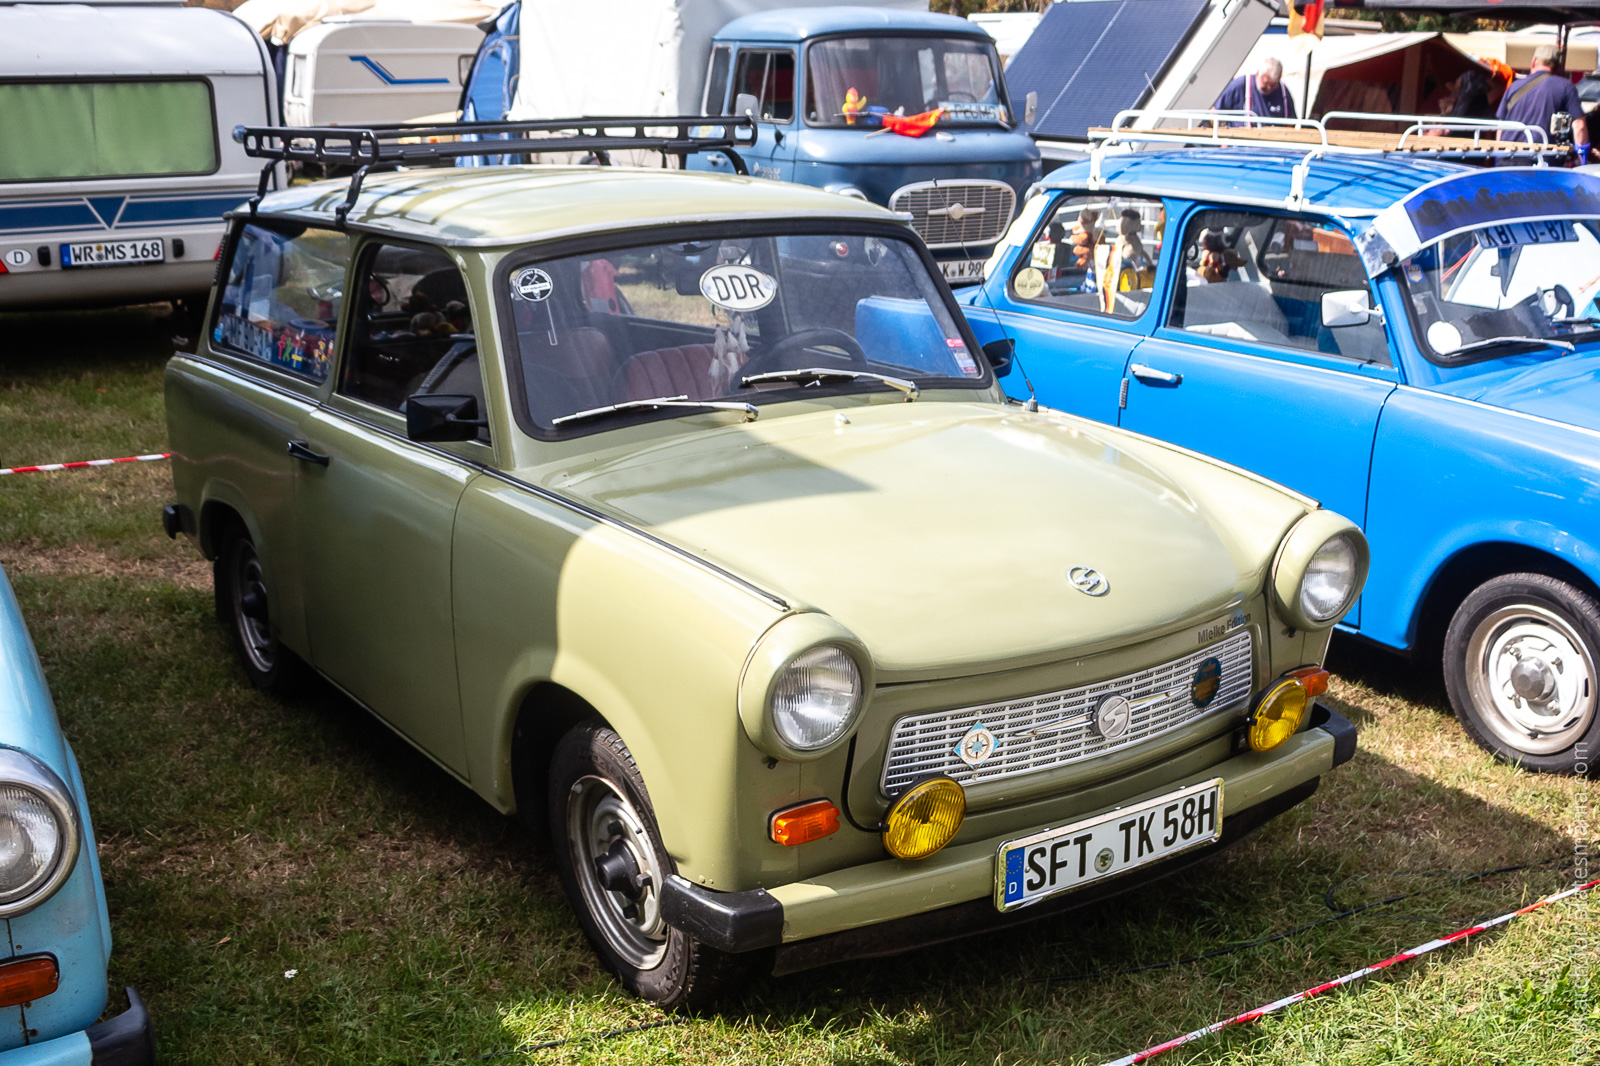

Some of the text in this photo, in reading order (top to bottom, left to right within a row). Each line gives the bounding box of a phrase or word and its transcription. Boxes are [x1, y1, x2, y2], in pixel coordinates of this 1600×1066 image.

[13, 251, 24, 264] D
[71, 242, 161, 262] WR MS 168
[711, 273, 766, 302] DDR
[1197, 613, 1251, 644] Mielke Edition
[1026, 790, 1216, 892] SFT TK 58H
[1008, 881, 1018, 895] D
